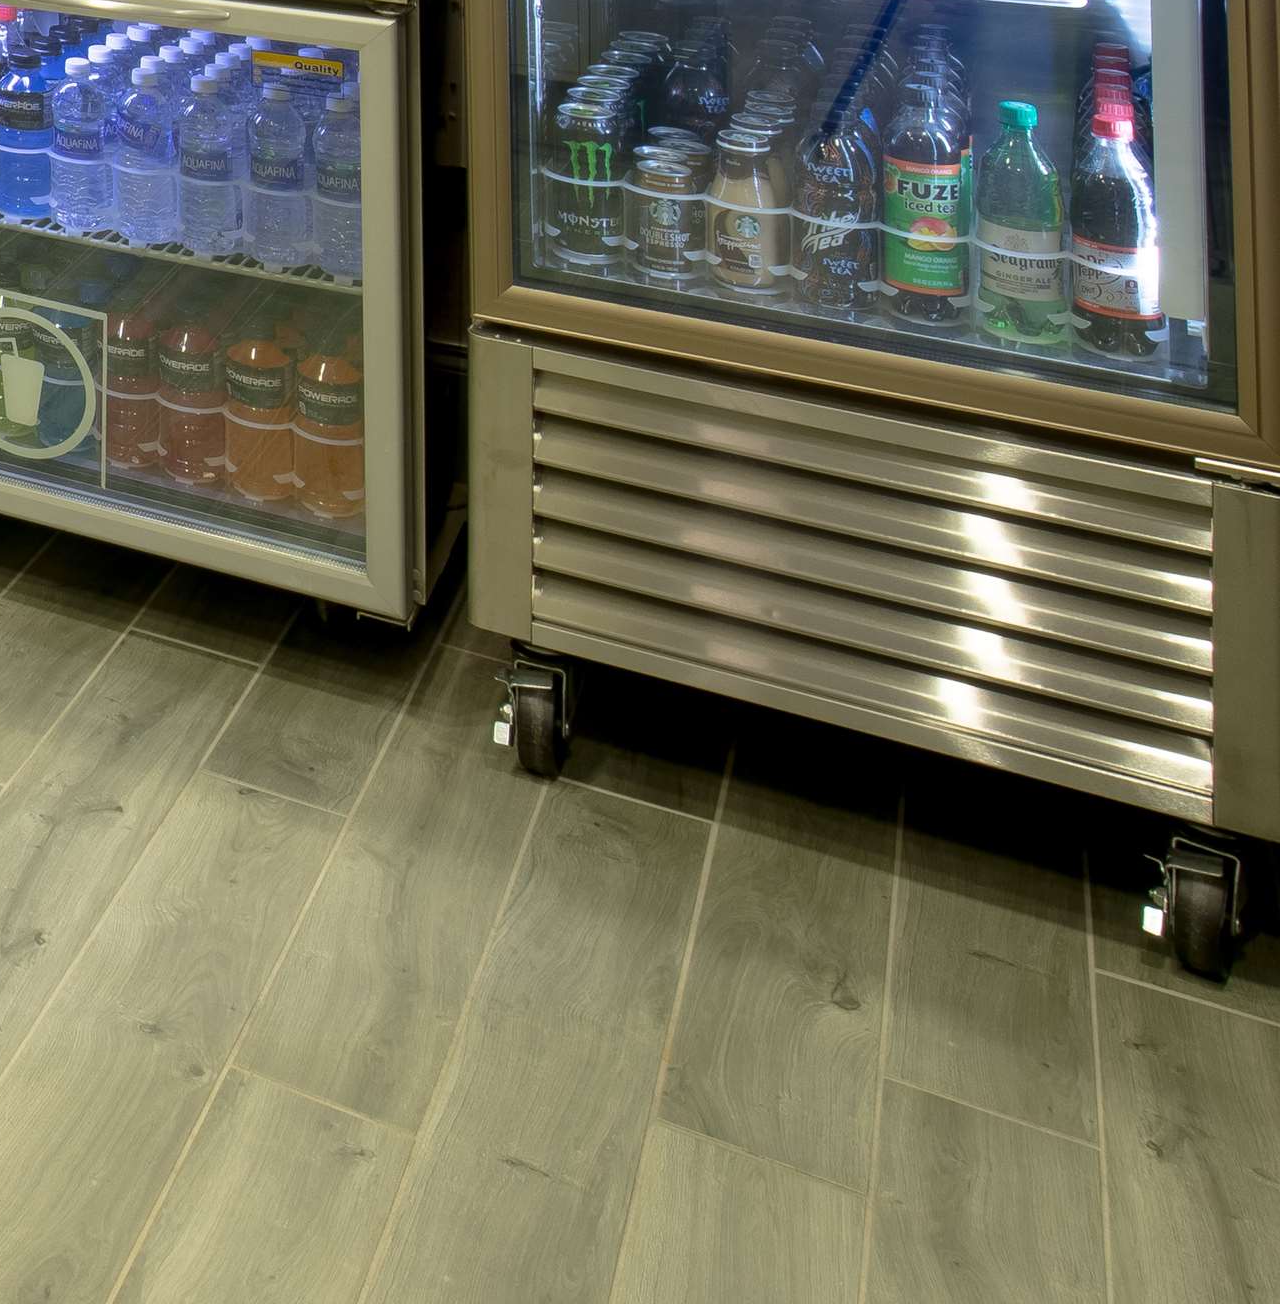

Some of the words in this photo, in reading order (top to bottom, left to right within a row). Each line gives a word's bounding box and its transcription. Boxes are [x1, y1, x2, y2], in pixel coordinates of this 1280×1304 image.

[294, 60, 341, 77] Quality
[56, 136, 98, 152] AQUAFINA
[182, 155, 226, 173] AQUAFINA
[251, 162, 296, 180] AQUAFINA
[897, 178, 959, 201] FUZE
[904, 200, 933, 214] iced
[936, 202, 957, 214] tea
